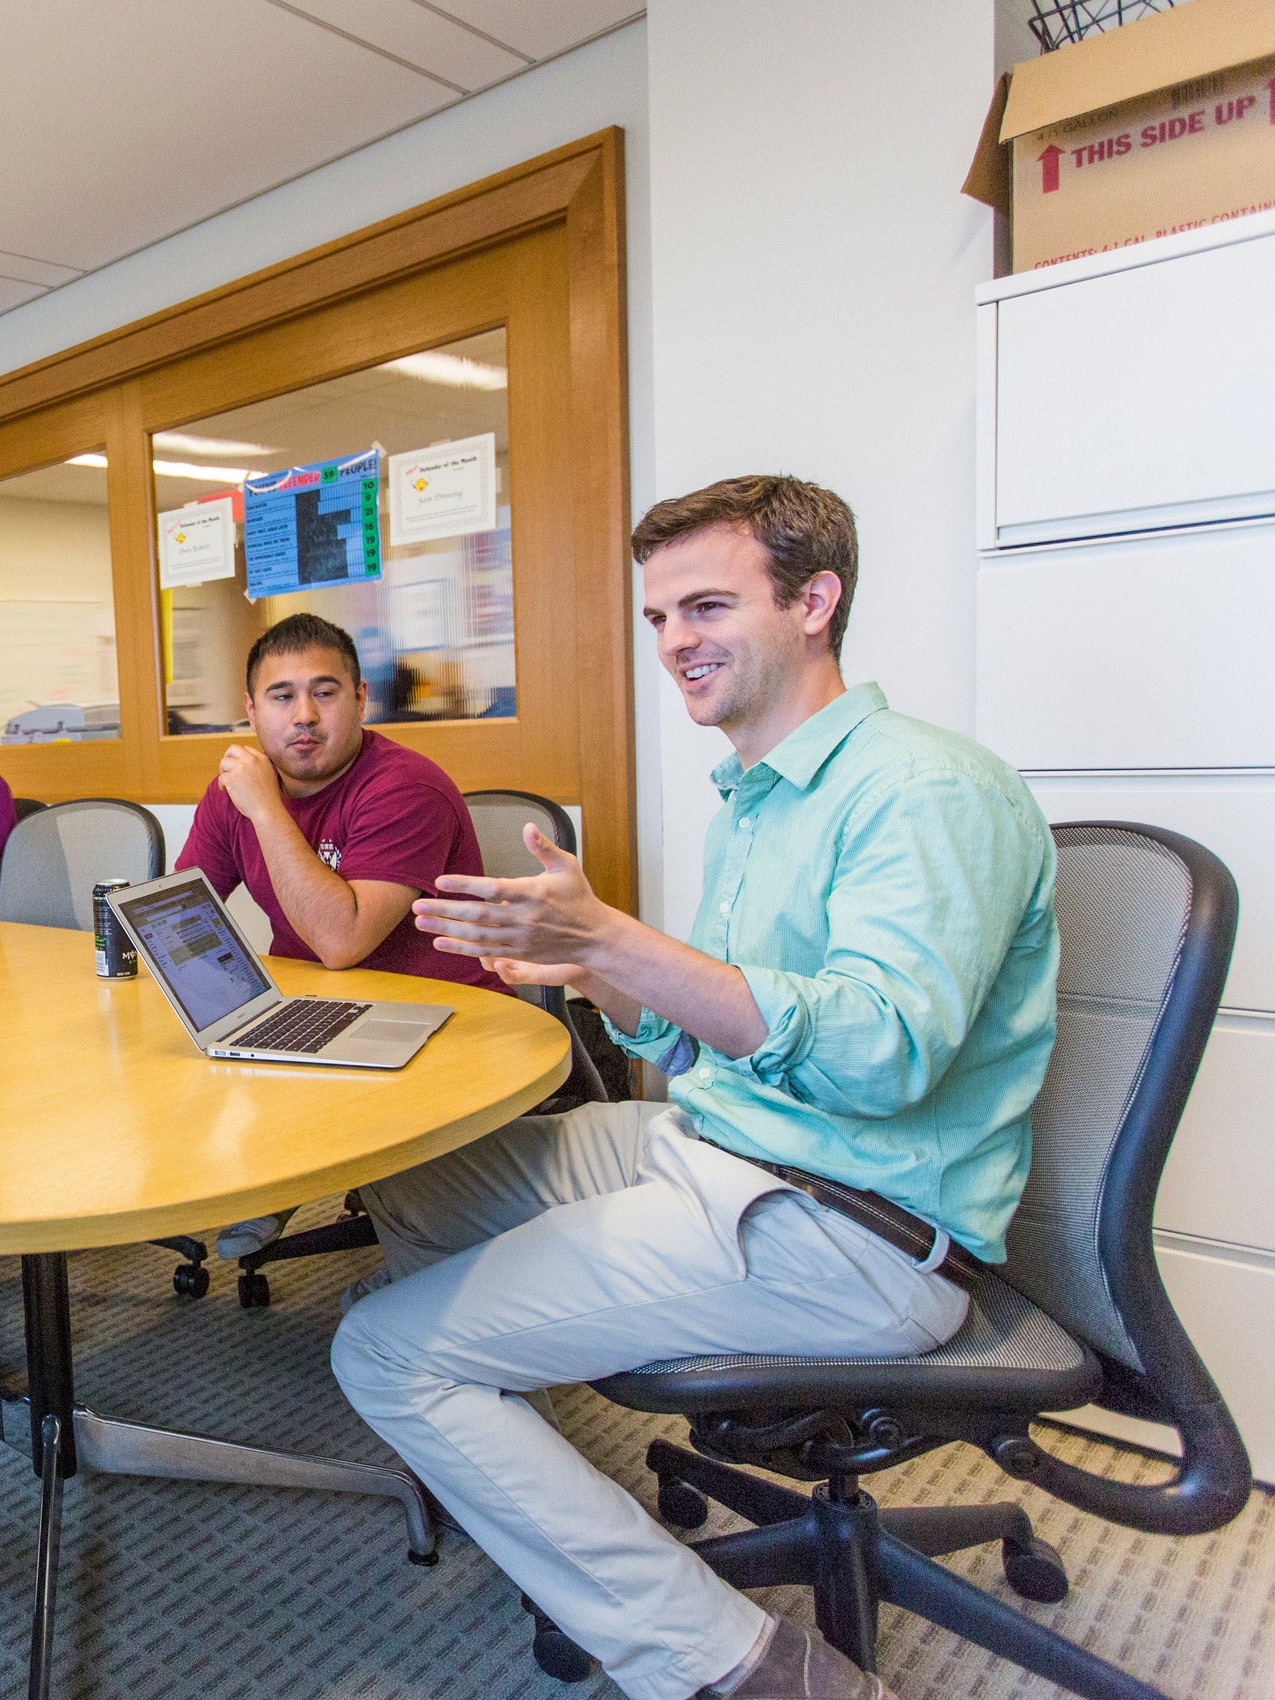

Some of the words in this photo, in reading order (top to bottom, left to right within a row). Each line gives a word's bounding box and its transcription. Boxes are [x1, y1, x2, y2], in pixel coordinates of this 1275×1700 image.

[1071, 133, 1132, 168] THIS
[1141, 110, 1205, 148] SIDE
[1214, 95, 1256, 125] UP
[339, 458, 377, 476] PEOPLE!
[364, 481, 374, 490] 10
[365, 507, 374, 516] 21
[366, 535, 375, 544] 19
[366, 549, 376, 557] 19
[367, 563, 377, 572] 19
